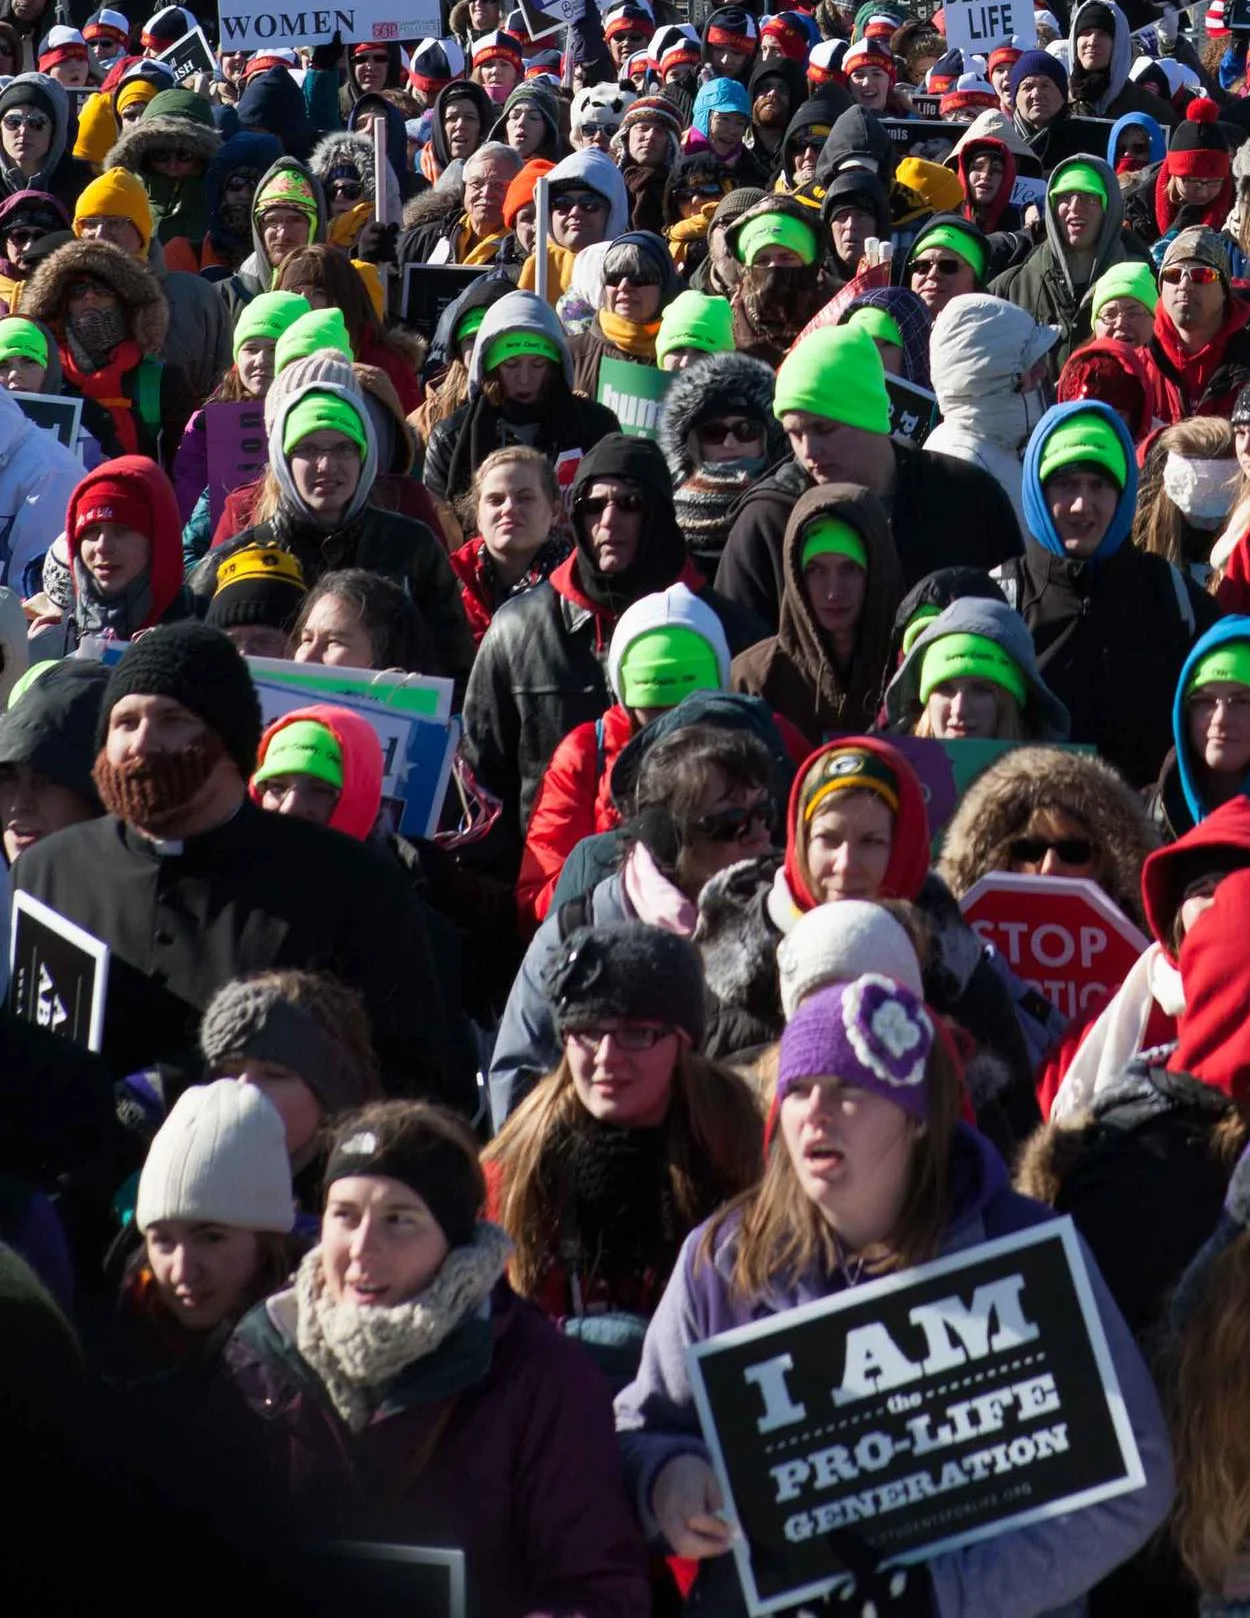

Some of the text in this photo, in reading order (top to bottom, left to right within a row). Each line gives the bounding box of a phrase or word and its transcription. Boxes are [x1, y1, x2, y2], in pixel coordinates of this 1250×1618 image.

[222, 10, 355, 40] WOMEN
[968, 4, 1014, 41] LIFE
[970, 919, 1107, 968] STOP
[744, 1273, 1040, 1435] I AM
[886, 1391, 923, 1416] the
[769, 1373, 1061, 1504] PRO-LIFE
[783, 1423, 1071, 1544] GENERATION
